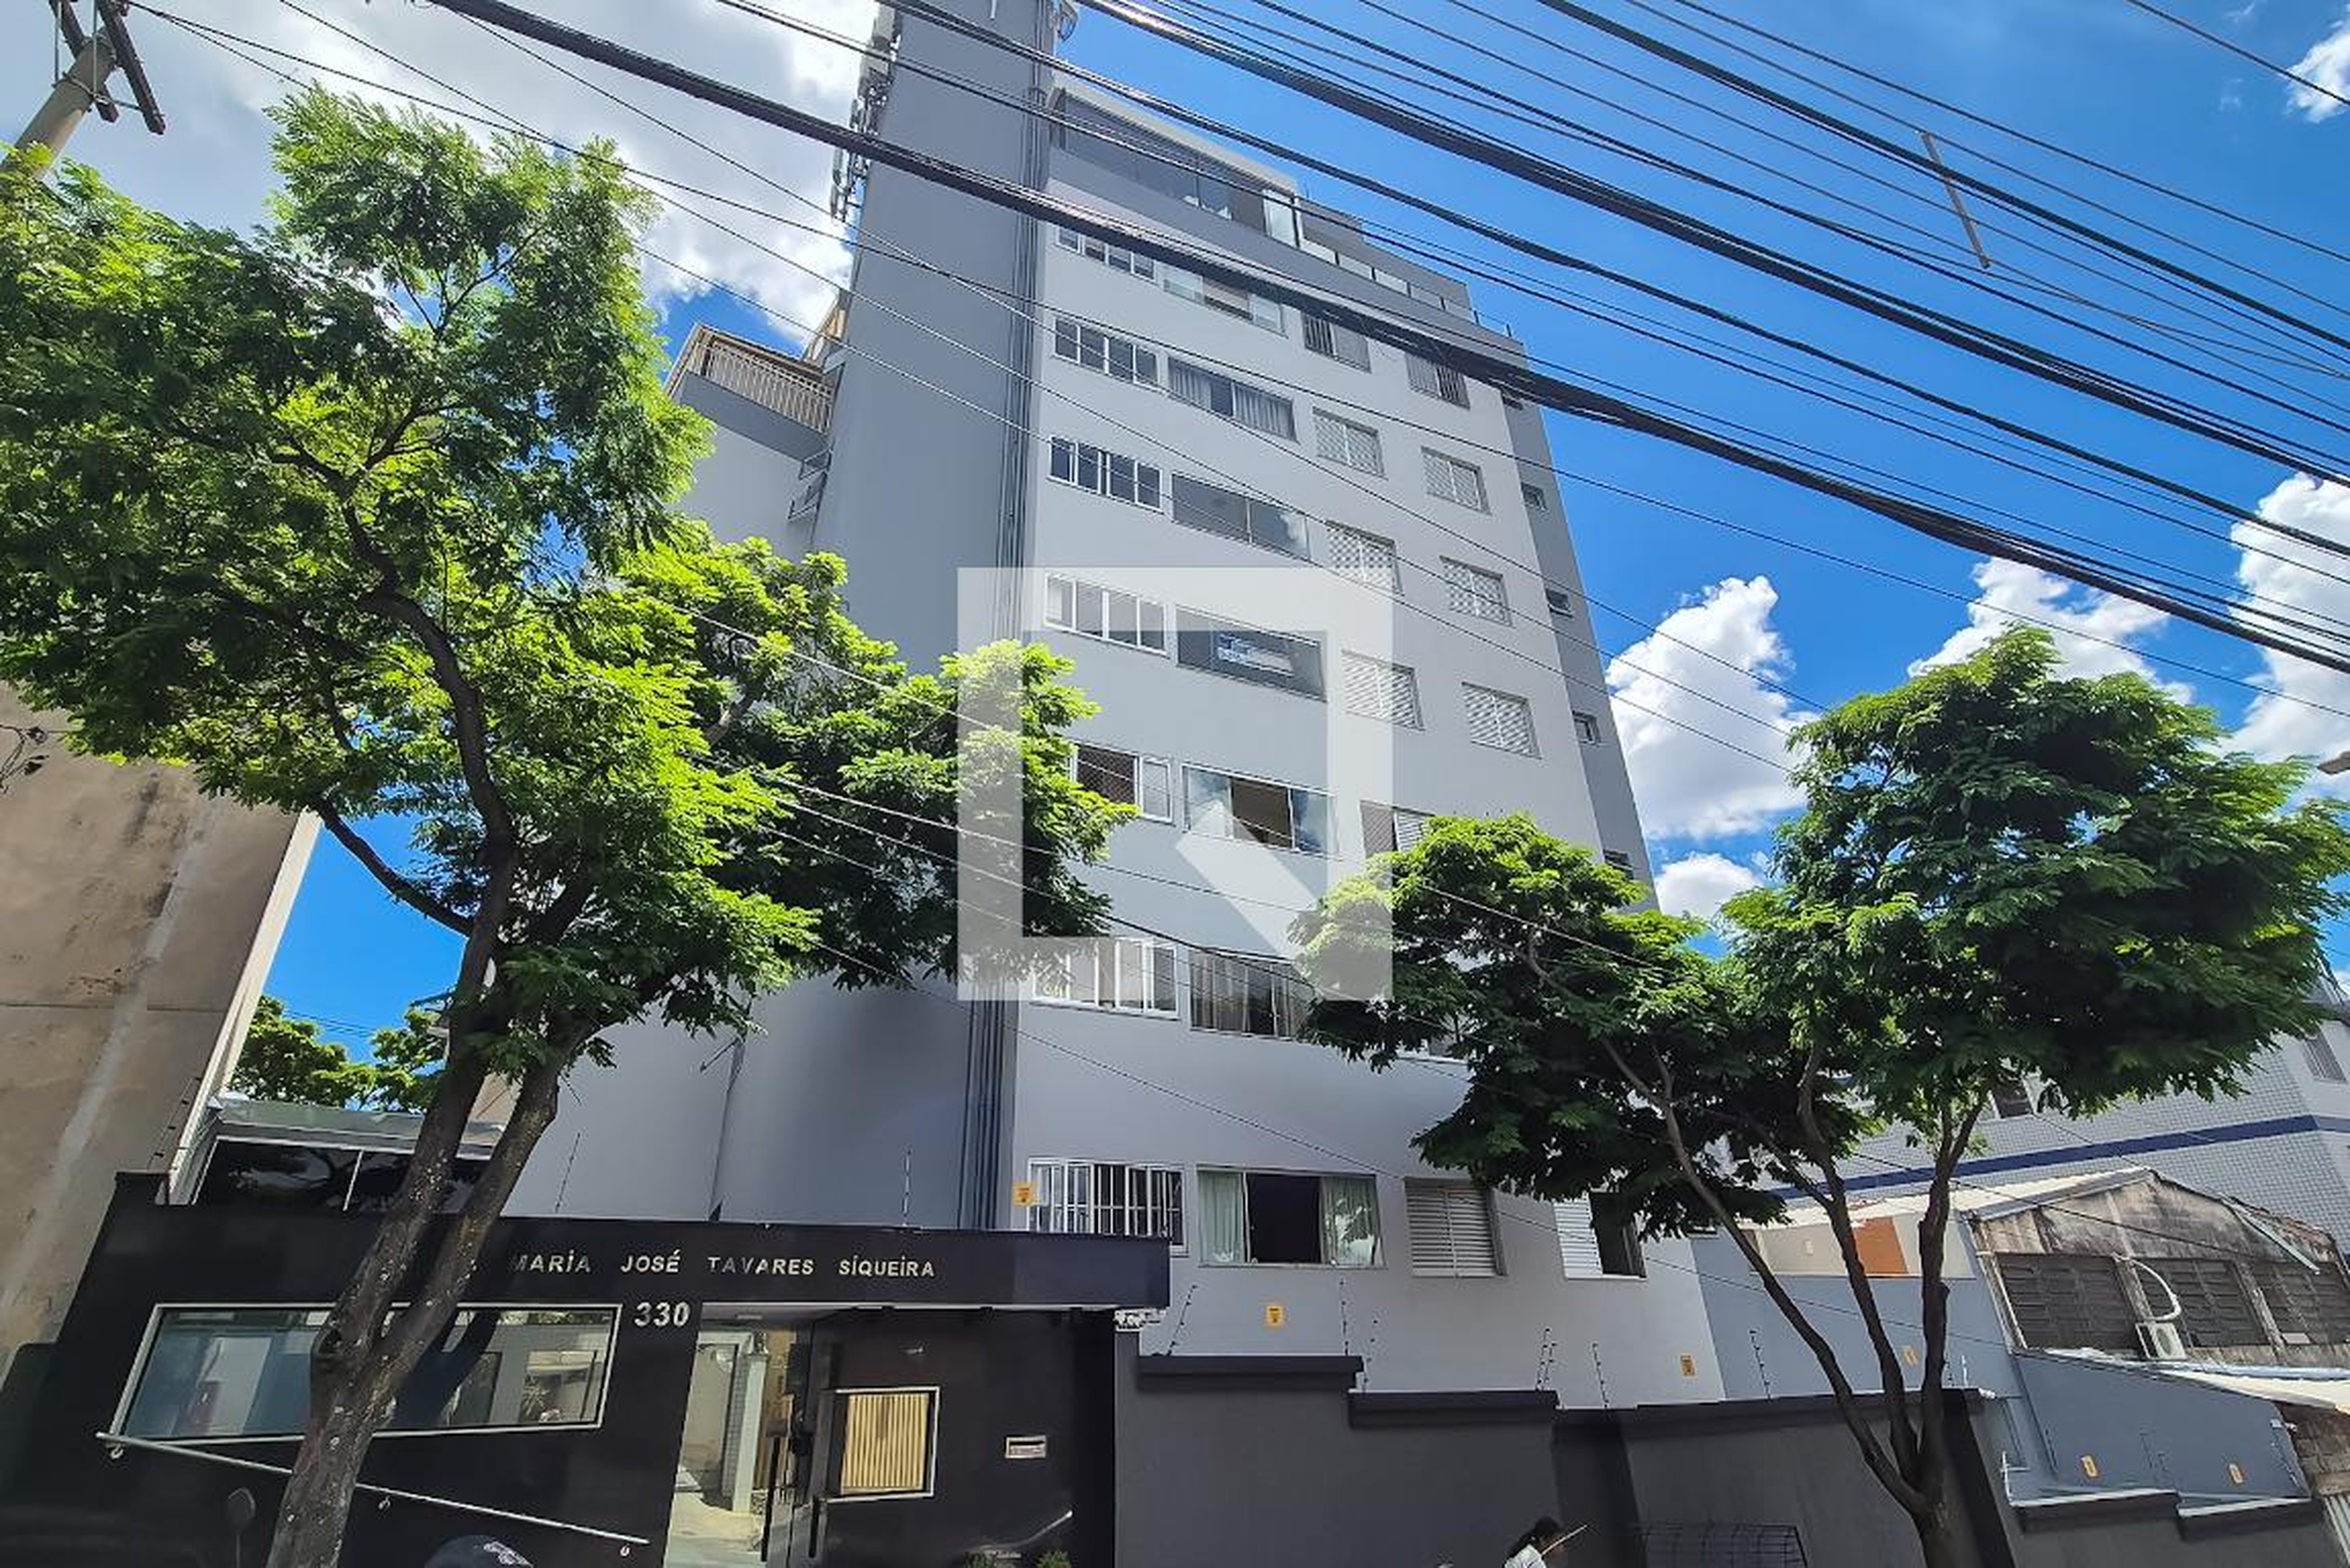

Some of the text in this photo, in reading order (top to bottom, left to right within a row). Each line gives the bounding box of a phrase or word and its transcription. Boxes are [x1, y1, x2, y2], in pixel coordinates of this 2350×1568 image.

[620, 1249, 681, 1273] JOSÉ
[707, 1256, 815, 1275] TAVARES
[634, 1301, 691, 1327] 330
